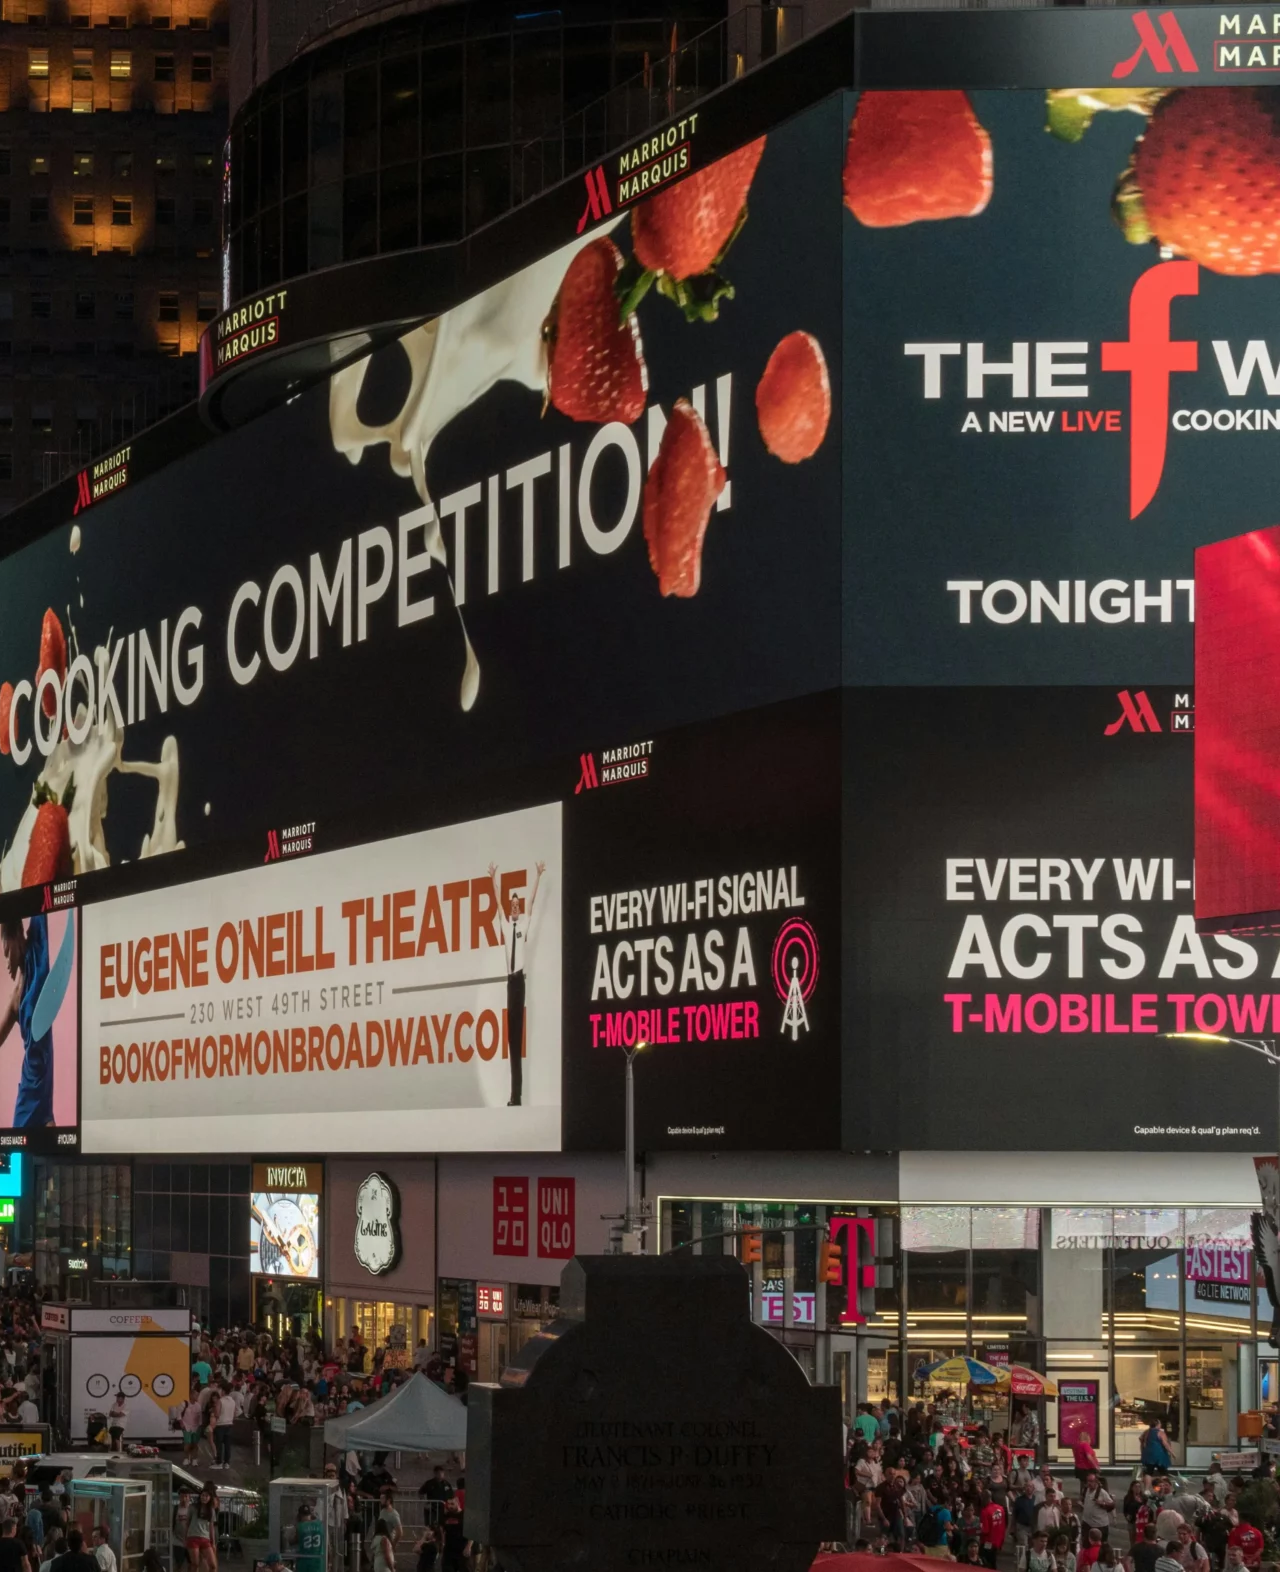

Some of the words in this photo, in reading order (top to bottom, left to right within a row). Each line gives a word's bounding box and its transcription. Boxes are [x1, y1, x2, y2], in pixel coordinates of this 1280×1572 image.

[620, 113, 698, 175] MARRIOTT
[620, 148, 688, 203] MARQUIS
[218, 291, 287, 340] MARRIOTT
[218, 321, 276, 366] MARQUIS
[904, 342, 1089, 398] THE
[961, 412, 983, 433] A
[989, 412, 1055, 433] NEW
[1062, 411, 1122, 433] LIVE
[1172, 409, 1280, 432] COOKIN
[93, 446, 131, 480] MARRIOTT
[93, 469, 127, 499] MARQUIS
[9, 606, 204, 765] COOKING
[602, 740, 654, 764] MARRIOTT
[602, 760, 648, 783] MARQUIS
[282, 822, 316, 840] MARRIOTT
[282, 838, 313, 855] MARQUIS
[53, 880, 77, 894] MARRIOTT
[946, 858, 1106, 901] EVERY
[1113, 858, 1195, 901] WI-
[53, 892, 75, 906] MARQUIS
[590, 887, 658, 934] EVERY
[660, 878, 715, 925] WI-FI
[717, 866, 805, 917] SIGNAL
[100, 926, 209, 1000] EUGENE
[215, 906, 335, 984] O'NEILL
[947, 913, 1146, 980] ACTS
[591, 935, 675, 1000] ACTS
[679, 930, 725, 993] AS
[730, 927, 757, 987] A
[190, 1003, 215, 1026] 230
[222, 996, 263, 1021] WEST
[271, 990, 311, 1015] 49TH
[320, 981, 385, 1011] STREET
[944, 993, 1159, 1033] T-MOBILE
[1167, 993, 1280, 1033] TOW
[590, 1008, 680, 1048] T-MOBILE
[684, 1001, 759, 1042] TOWER
[1133, 1125, 1165, 1135] Capable
[1166, 1126, 1190, 1134] device
[1191, 1126, 1197, 1134] &
[1222, 1126, 1238, 1135] plan
[267, 1166, 307, 1188] INVICTA
[541, 1186, 569, 1215] UNI
[541, 1220, 571, 1250] QLO
[1185, 1247, 1251, 1281] FASTEST
[492, 1289, 503, 1300] UNI
[492, 1301, 503, 1312] QLO
[513, 1299, 542, 1313] LifeWear
[1197, 1283, 1206, 1296] 4G
[1207, 1284, 1219, 1298] LTE
[1220, 1285, 1250, 1301] NETWOR
[109, 1315, 153, 1324] COFFEED
[694, 1445, 776, 1467] DUFFY
[303, 1534, 321, 1549] 23
